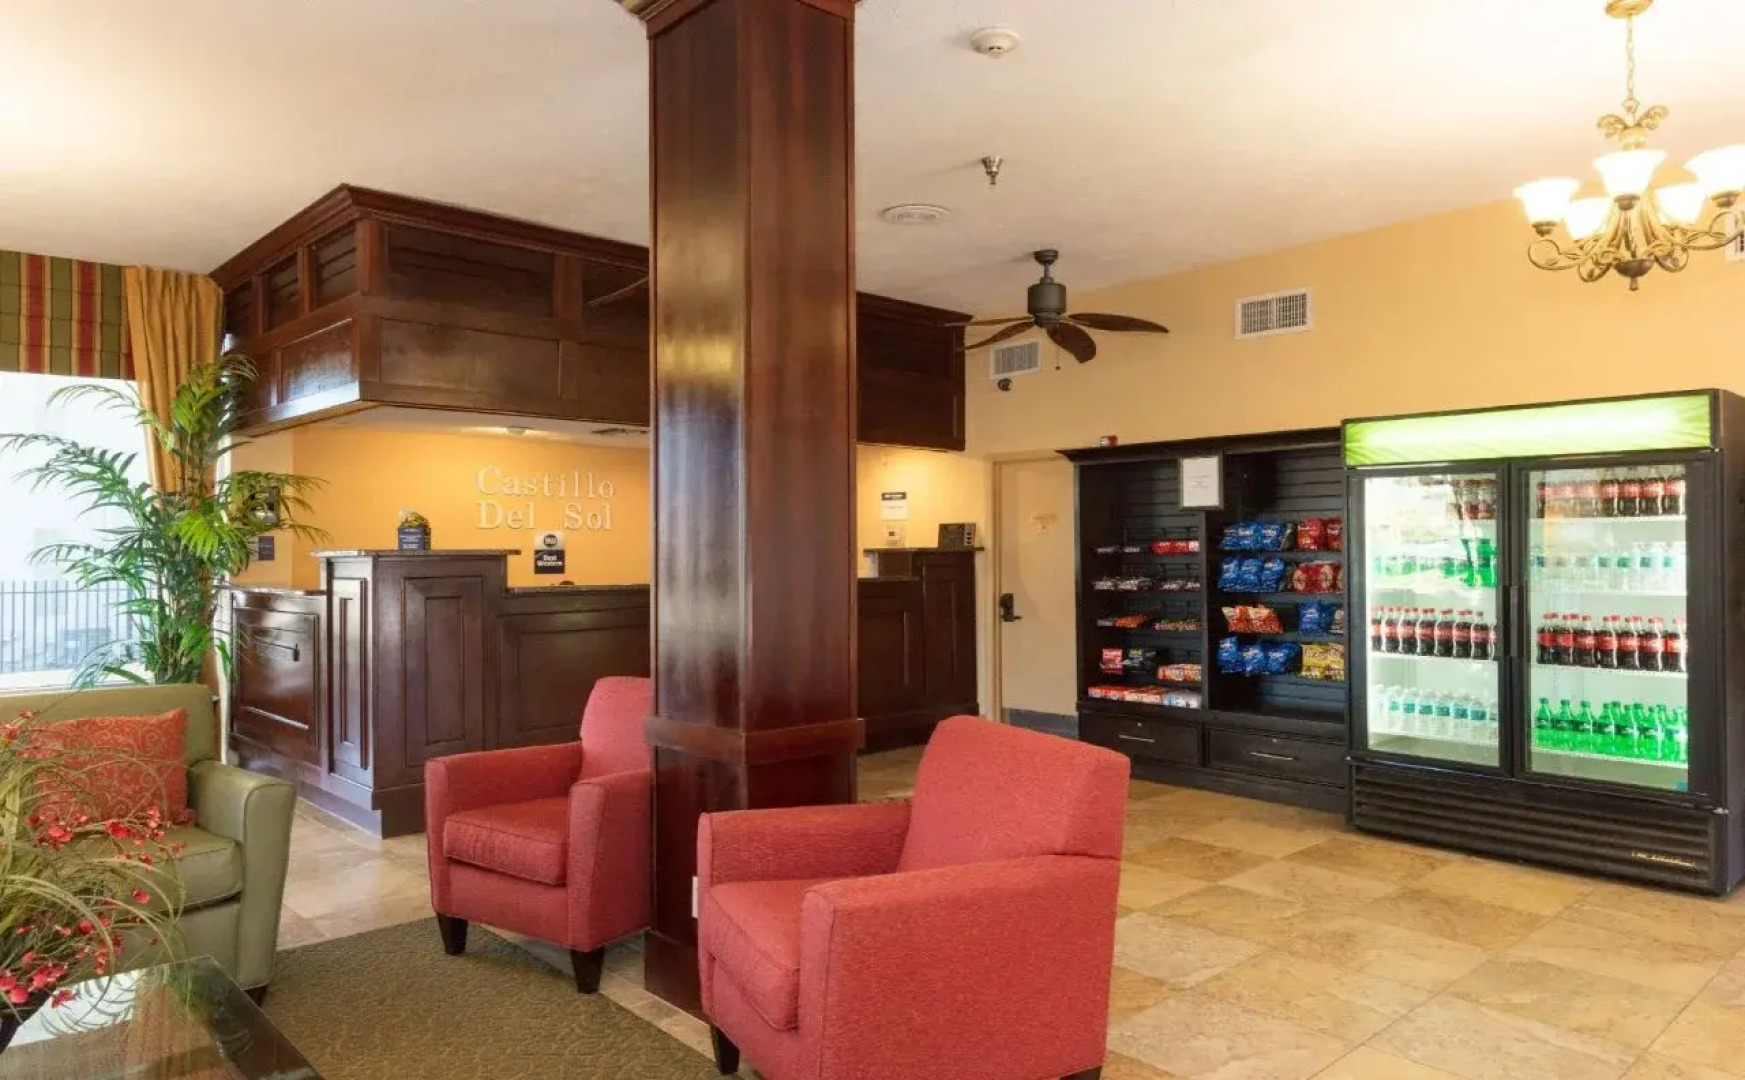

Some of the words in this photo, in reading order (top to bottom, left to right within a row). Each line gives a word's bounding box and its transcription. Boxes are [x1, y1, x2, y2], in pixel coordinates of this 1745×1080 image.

[477, 466, 615, 499] Castillo
[476, 501, 535, 529] Del
[563, 503, 612, 530] Sol
